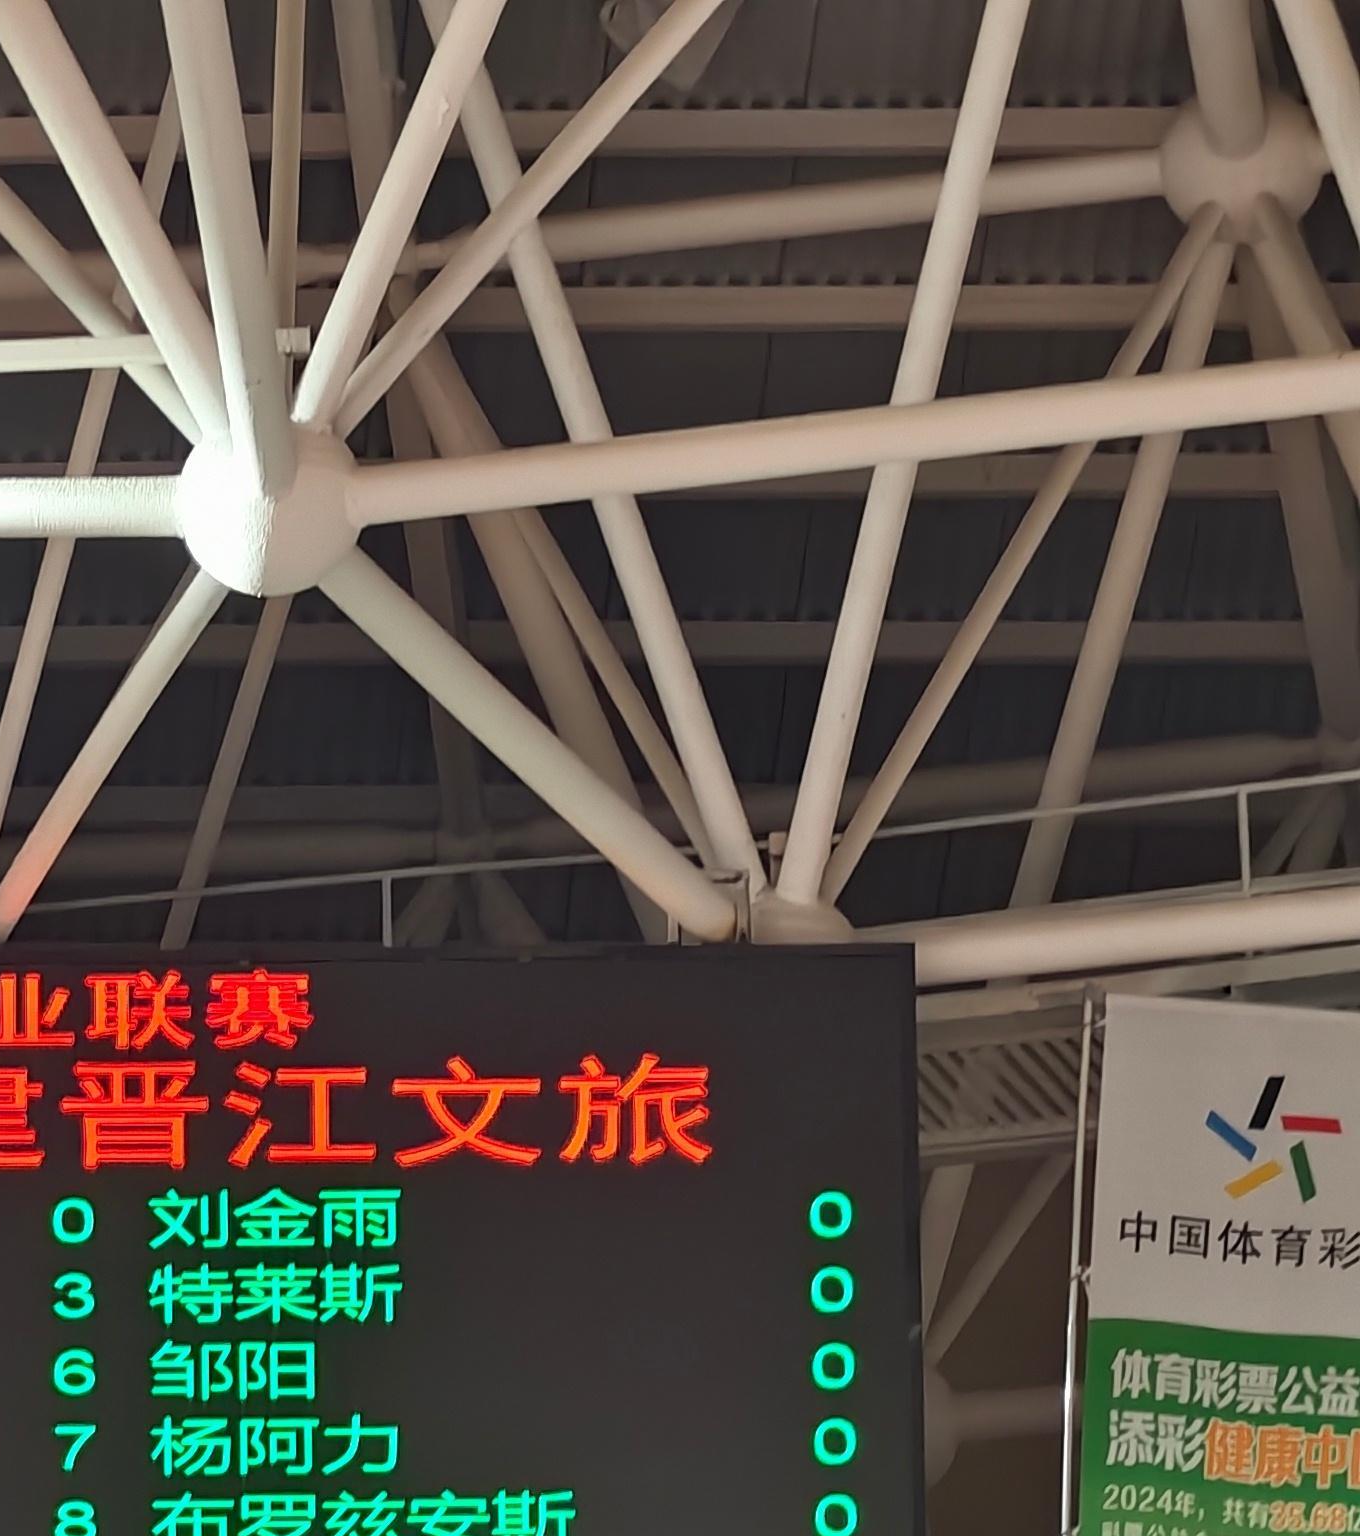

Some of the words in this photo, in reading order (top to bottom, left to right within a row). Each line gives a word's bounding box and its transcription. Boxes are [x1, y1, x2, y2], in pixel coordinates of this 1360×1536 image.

[51, 1197, 94, 1245] 0
[148, 1187, 401, 1251] 刘金雨
[808, 1190, 855, 1241] 0
[1118, 1209, 1360, 1270] 中国体育彩
[52, 1271, 95, 1321] 3
[148, 1259, 403, 1328] 特莱斯
[809, 1265, 856, 1316] 0
[51, 1347, 96, 1399] 6
[149, 1338, 316, 1404] 邹阳
[810, 1340, 857, 1392] 0
[1110, 1347, 1360, 1417] 体育彩票公益
[52, 1422, 97, 1472] 7
[150, 1411, 399, 1478] 杨阿力
[811, 1416, 859, 1467] 0
[1105, 1409, 1360, 1490] 添彩健康中
